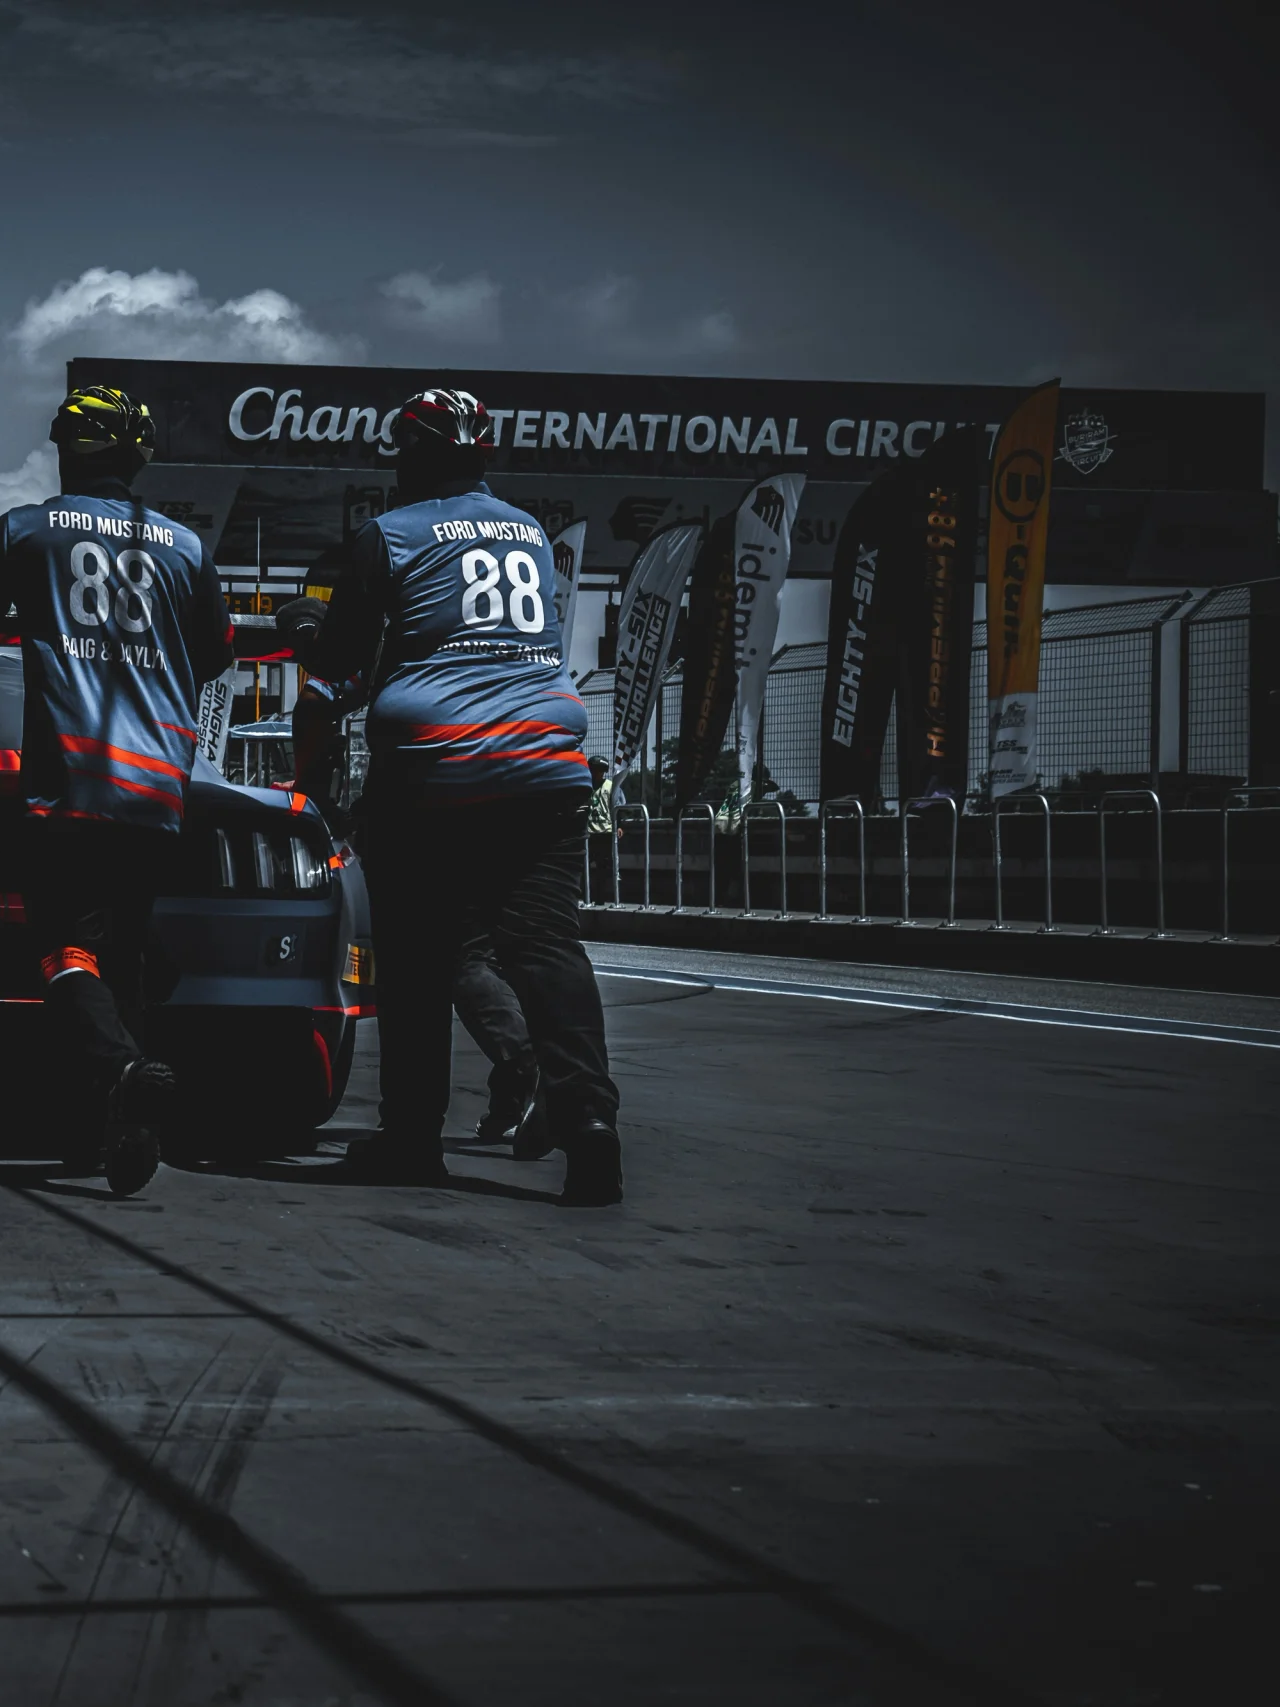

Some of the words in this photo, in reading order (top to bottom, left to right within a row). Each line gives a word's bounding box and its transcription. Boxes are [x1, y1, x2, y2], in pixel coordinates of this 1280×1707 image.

[486, 409, 808, 456] TERNATIONAL
[48, 510, 93, 531] FORD
[96, 516, 174, 547] MUSTANG
[432, 520, 478, 543] FORD
[476, 520, 543, 548] MUSTANG
[69, 541, 155, 633] 88
[461, 548, 545, 634] 88
[100, 641, 113, 662] &
[626, 600, 666, 737] CHALLENGE
[832, 543, 878, 748] EIGHTY-SIX
[207, 680, 228, 762] SINGHA
